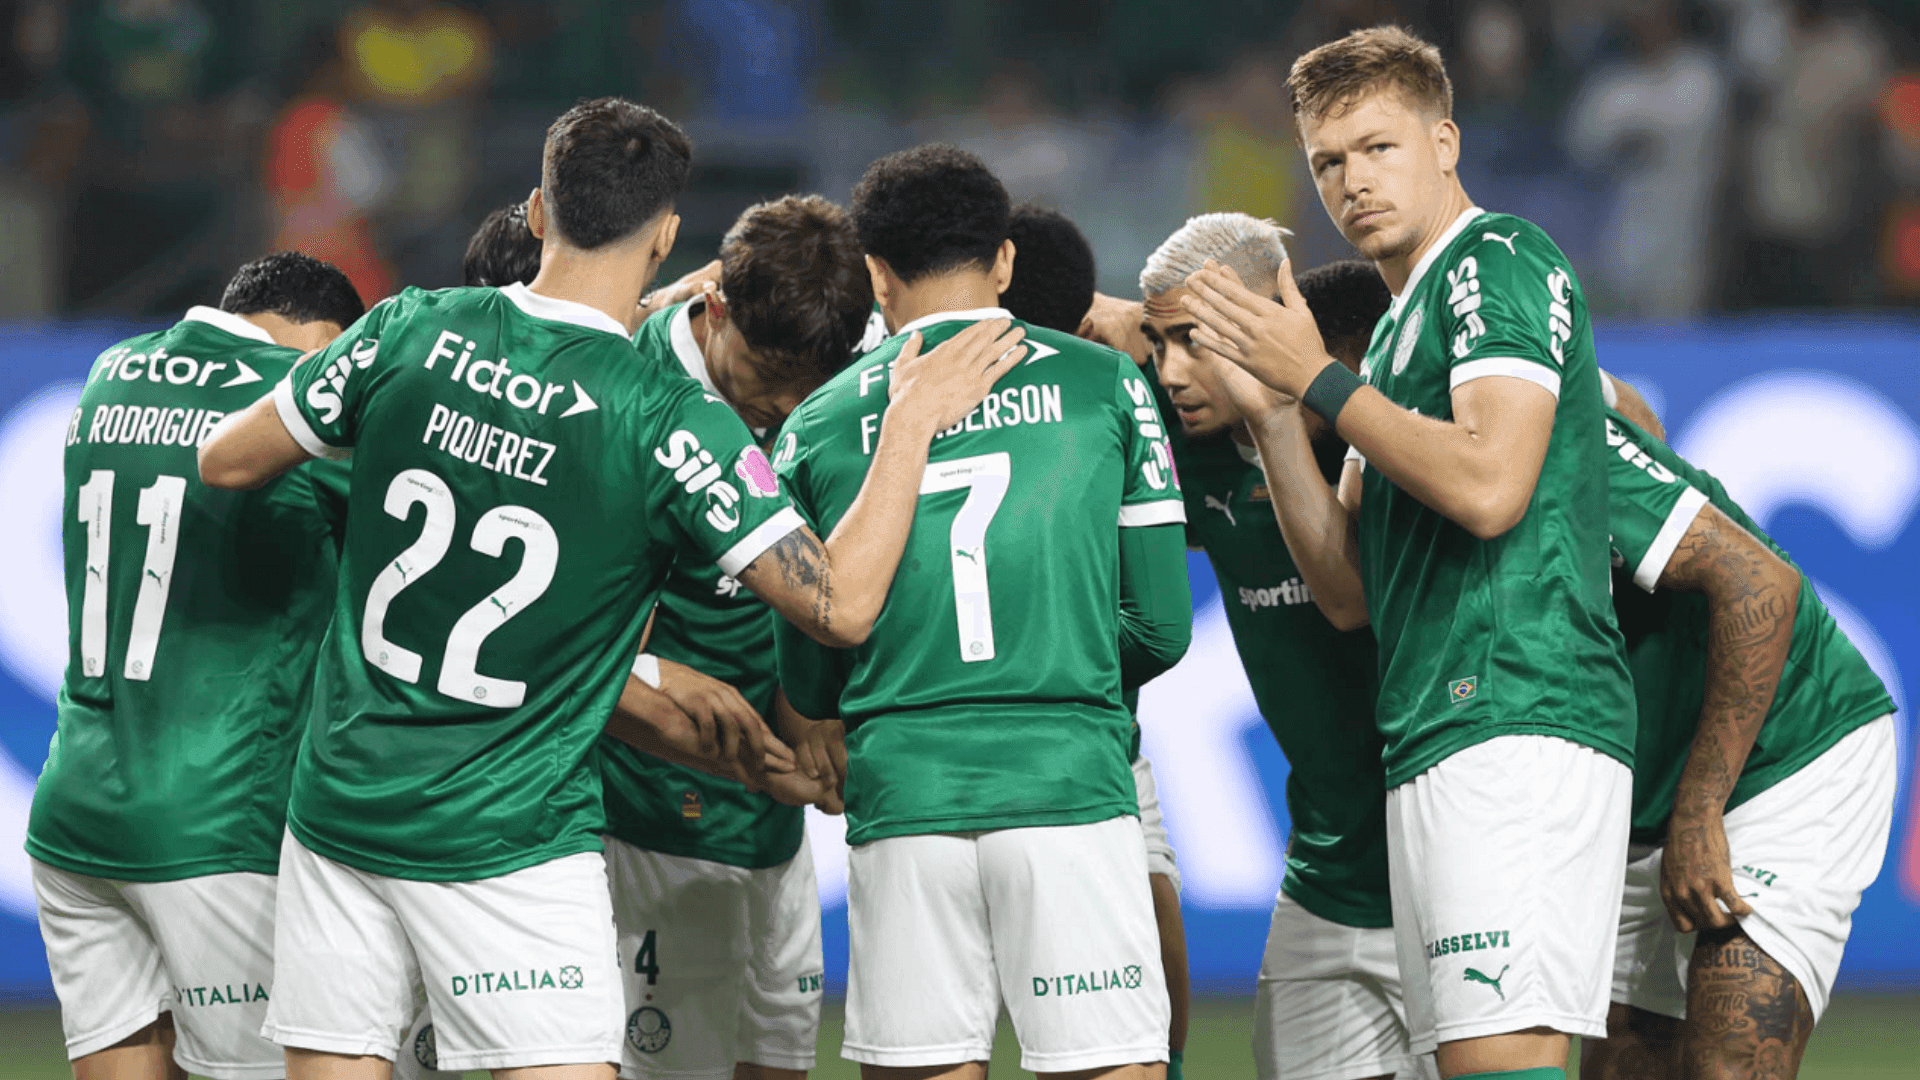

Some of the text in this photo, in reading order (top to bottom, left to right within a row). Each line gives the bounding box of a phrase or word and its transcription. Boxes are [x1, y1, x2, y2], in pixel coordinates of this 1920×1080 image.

[90, 347, 227, 387] Fictor
[423, 329, 565, 415] Fictor
[67, 404, 225, 449] B. RODRIGUE
[936, 384, 1063, 439] ERSON
[422, 403, 556, 486] PIQUEREZ
[78, 470, 187, 681] 11
[917, 450, 1011, 663] 7
[361, 468, 559, 709] 22
[1239, 577, 1316, 612] sportin
[452, 969, 556, 996] D'ITALIA
[634, 929, 659, 986] 4
[1032, 969, 1122, 997] D'ITALIA
